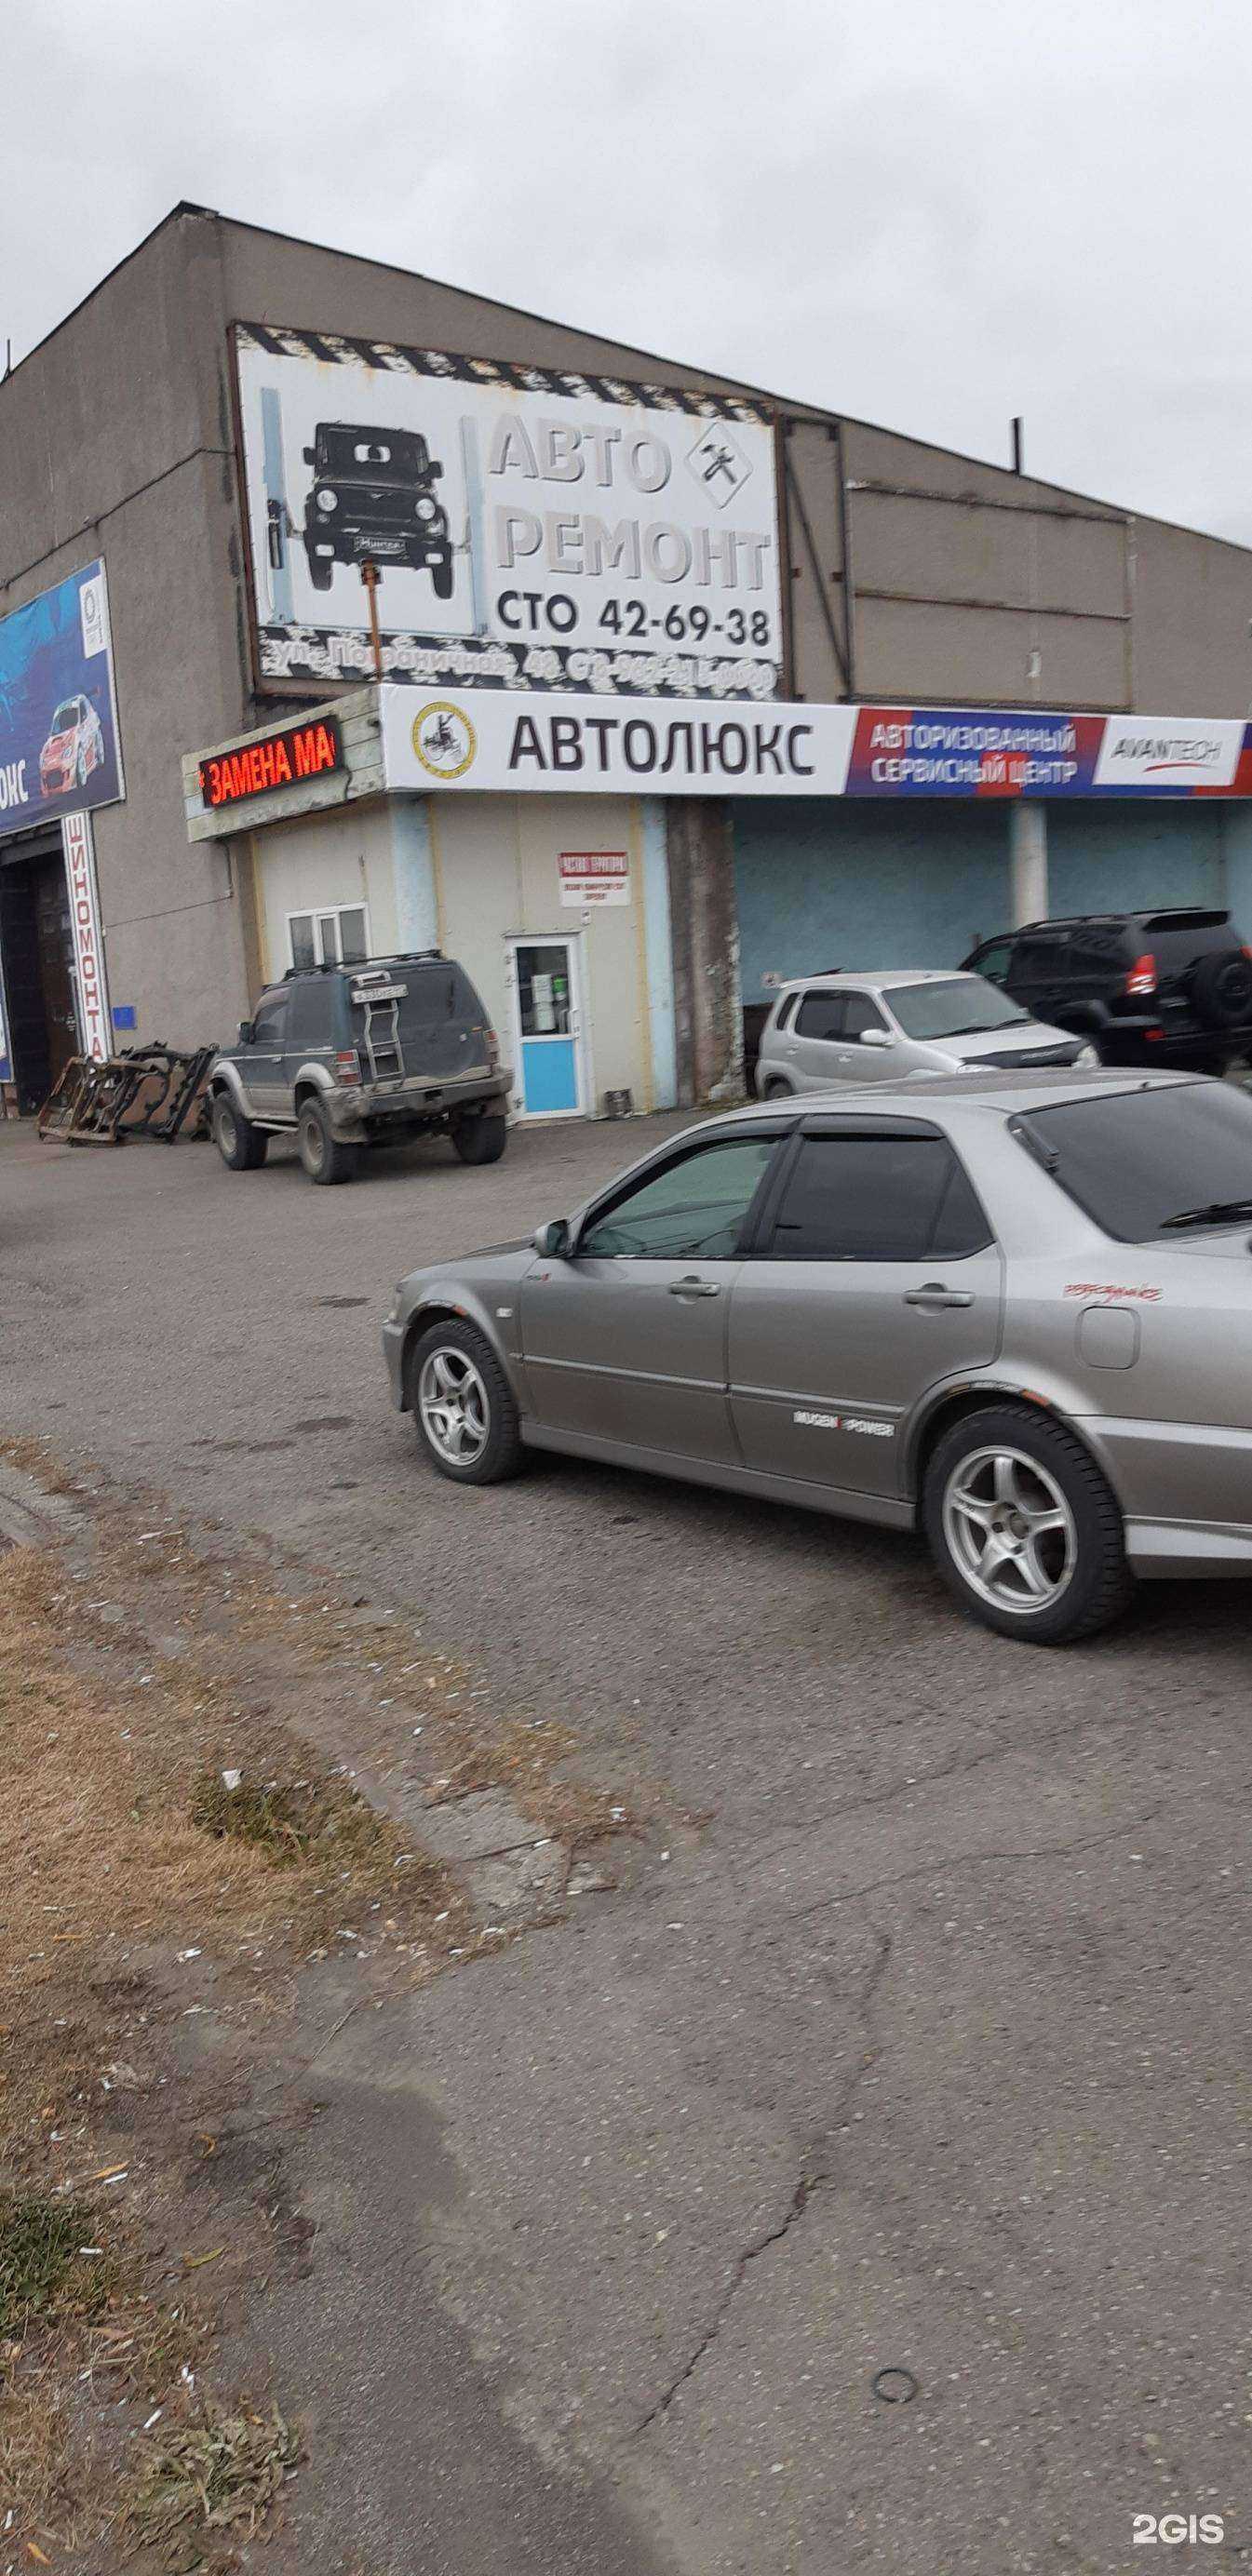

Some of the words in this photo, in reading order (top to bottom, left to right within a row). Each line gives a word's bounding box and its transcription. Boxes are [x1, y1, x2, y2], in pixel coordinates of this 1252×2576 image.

[489, 414, 672, 493] АВТО
[495, 504, 771, 590] РЕМОНТ
[497, 590, 578, 633] СТО
[599, 598, 771, 647] 42-69-38
[209, 740, 293, 805] ЗАМЕНА
[292, 725, 336, 777] МА
[508, 715, 816, 776] АВТОЛЮКС
[869, 722, 1078, 754] АВТОРИЗОВАННЫЙ
[1111, 738, 1222, 761] AVANTECH
[870, 754, 1005, 785] СЕРВИСНЫЙ
[1007, 758, 1079, 788] ЦЕНТР
[67, 815, 104, 1062] ШИНОМОНТА
